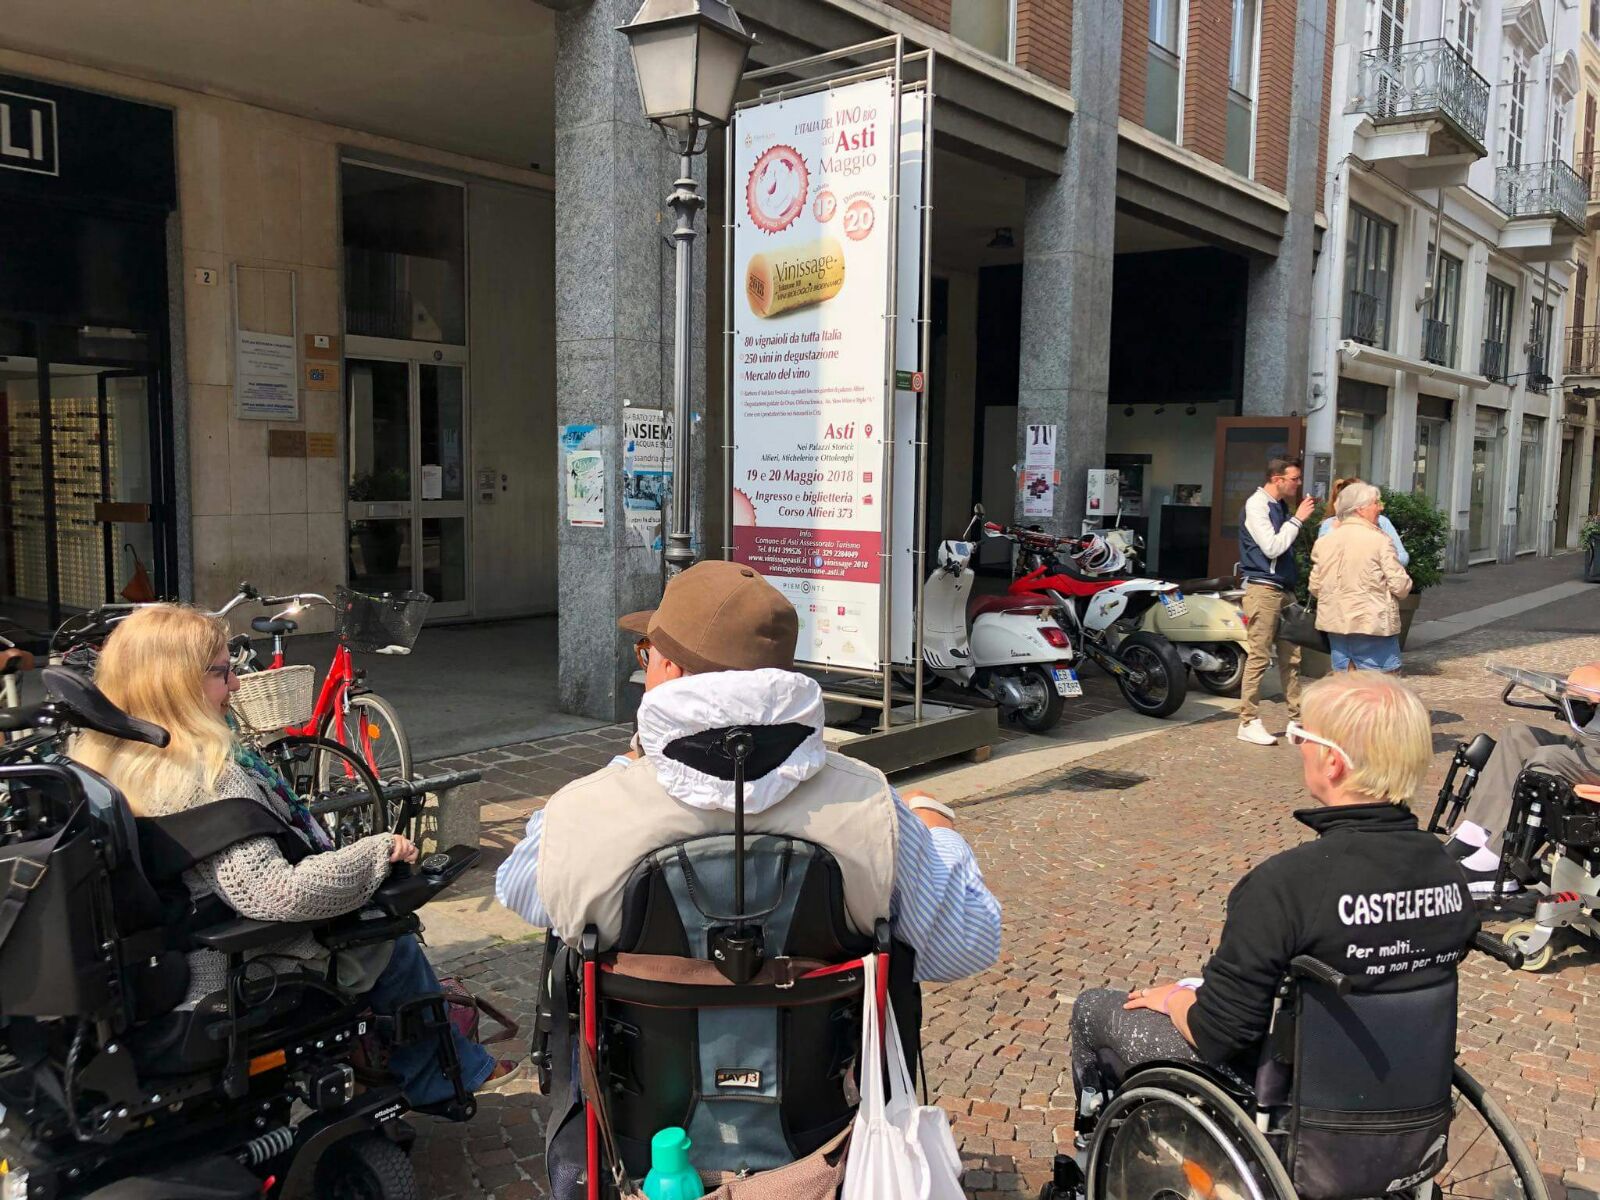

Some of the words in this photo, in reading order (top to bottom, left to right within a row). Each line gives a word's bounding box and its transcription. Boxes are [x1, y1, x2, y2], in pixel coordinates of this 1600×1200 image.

[794, 121, 819, 135] L'ITALIA
[821, 118, 833, 130] DEL
[837, 106, 861, 126] VINO
[863, 108, 877, 121] BIO
[822, 132, 834, 146] ad
[835, 123, 875, 153] Asti
[819, 150, 876, 176] Maggio
[845, 208, 872, 232] 20
[204, 271, 210, 283] 2
[744, 336, 753, 347] 80
[755, 333, 787, 349] vignaioli
[789, 332, 799, 344] da
[801, 331, 820, 343] tutta
[822, 329, 842, 341] Italia
[744, 353, 758, 364] 250
[759, 352, 773, 363] vini
[774, 351, 782, 362] in
[784, 348, 839, 364] degustazione
[744, 370, 776, 381] Mercato
[778, 368, 791, 380] del
[792, 368, 810, 379] vino
[824, 421, 855, 439] Asti
[797, 443, 807, 451] Nei
[809, 443, 830, 451] Palazzi
[761, 454, 780, 462] Alfieri,
[782, 454, 814, 462] Michelerio
[821, 454, 854, 463] Ottolenghi
[746, 469, 758, 481] 19
[761, 472, 766, 481] e
[769, 469, 781, 481] 20
[783, 469, 824, 485] Maggio
[827, 470, 853, 482] 2018
[755, 491, 793, 503] Ingresso
[803, 491, 853, 505] biglietteria
[778, 506, 804, 517] Corso
[806, 506, 835, 518] Alfieri
[837, 508, 853, 518] 373
[755, 537, 779, 545] Comune
[800, 538, 835, 548] Assessorato
[836, 541, 861, 549] Turismo
[748, 555, 807, 564] www.vinissageasti.it
[823, 560, 852, 569] vinissage
[853, 560, 869, 568] 2018
[769, 563, 845, 576] vinissage@comune.asti.it
[783, 581, 825, 594] PIEMONTE
[1338, 883, 1463, 925] CASTELFERRO
[1346, 945, 1373, 959] Per
[1379, 940, 1425, 956] molti...
[1366, 965, 1385, 975] ma
[1389, 961, 1408, 972] non
[1411, 957, 1431, 973] per
[1436, 951, 1459, 965] tutti
